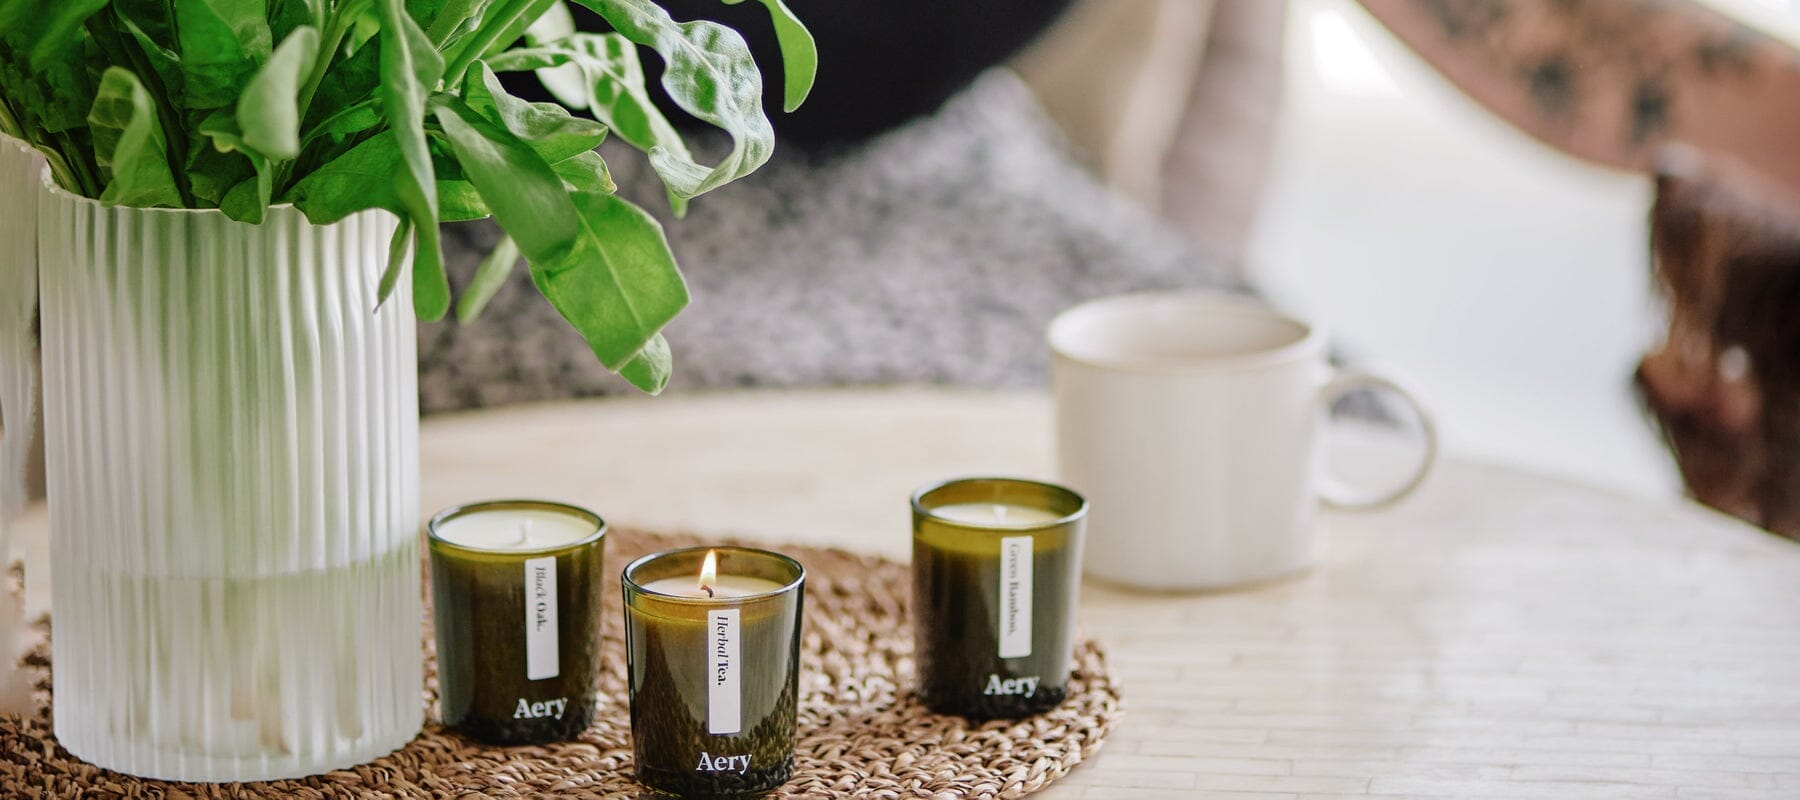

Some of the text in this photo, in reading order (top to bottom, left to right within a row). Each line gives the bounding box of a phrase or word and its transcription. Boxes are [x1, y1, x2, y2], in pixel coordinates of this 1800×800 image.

[535, 567, 547, 632] Black Oak.
[717, 616, 729, 686] Herbal Tea.
[984, 674, 1040, 699] Aery
[513, 697, 568, 720] Aery
[695, 751, 752, 775] Aery
